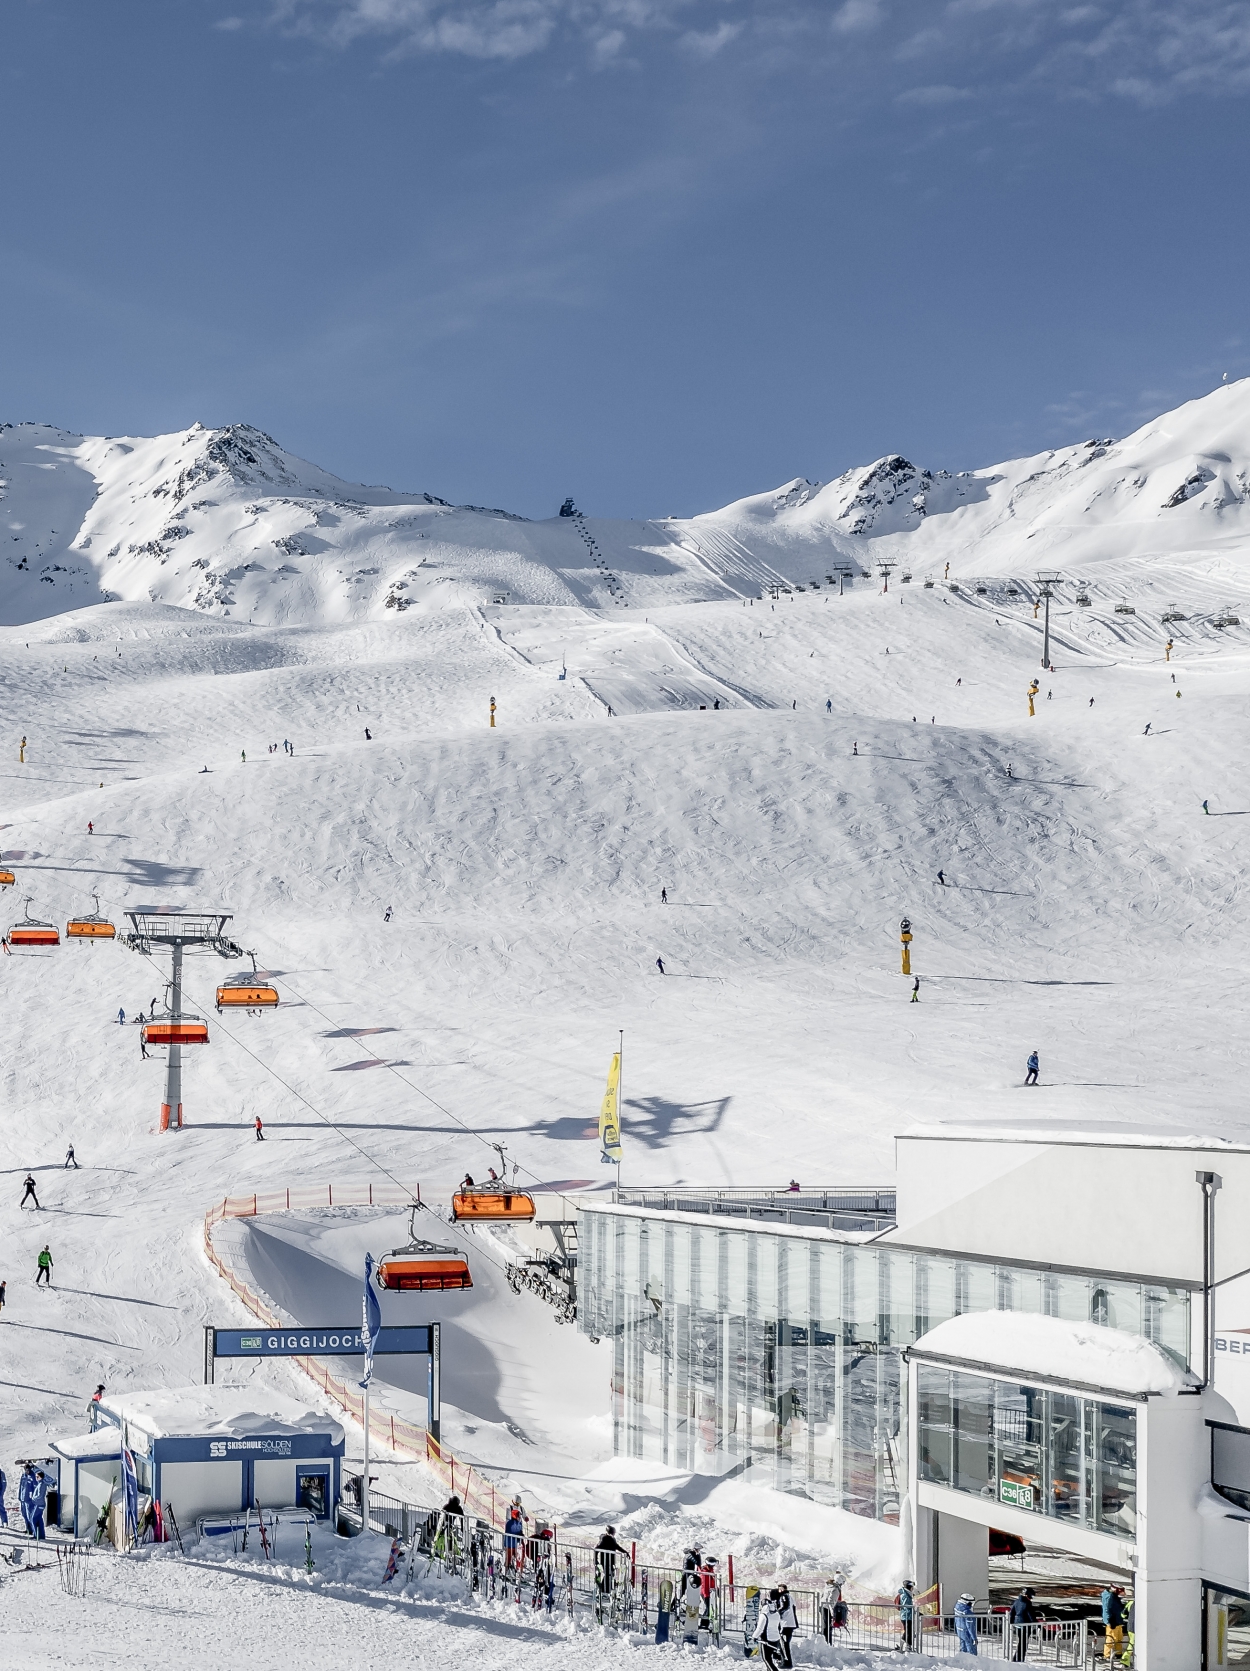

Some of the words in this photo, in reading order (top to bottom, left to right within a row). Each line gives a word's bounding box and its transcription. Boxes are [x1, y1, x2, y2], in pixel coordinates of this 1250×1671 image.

[267, 1335, 362, 1349] GIGGIJOCH
[227, 1441, 261, 1450] SKISCHULE
[1002, 1486, 1017, 1499] C36
[1025, 1490, 1031, 1502] 8
